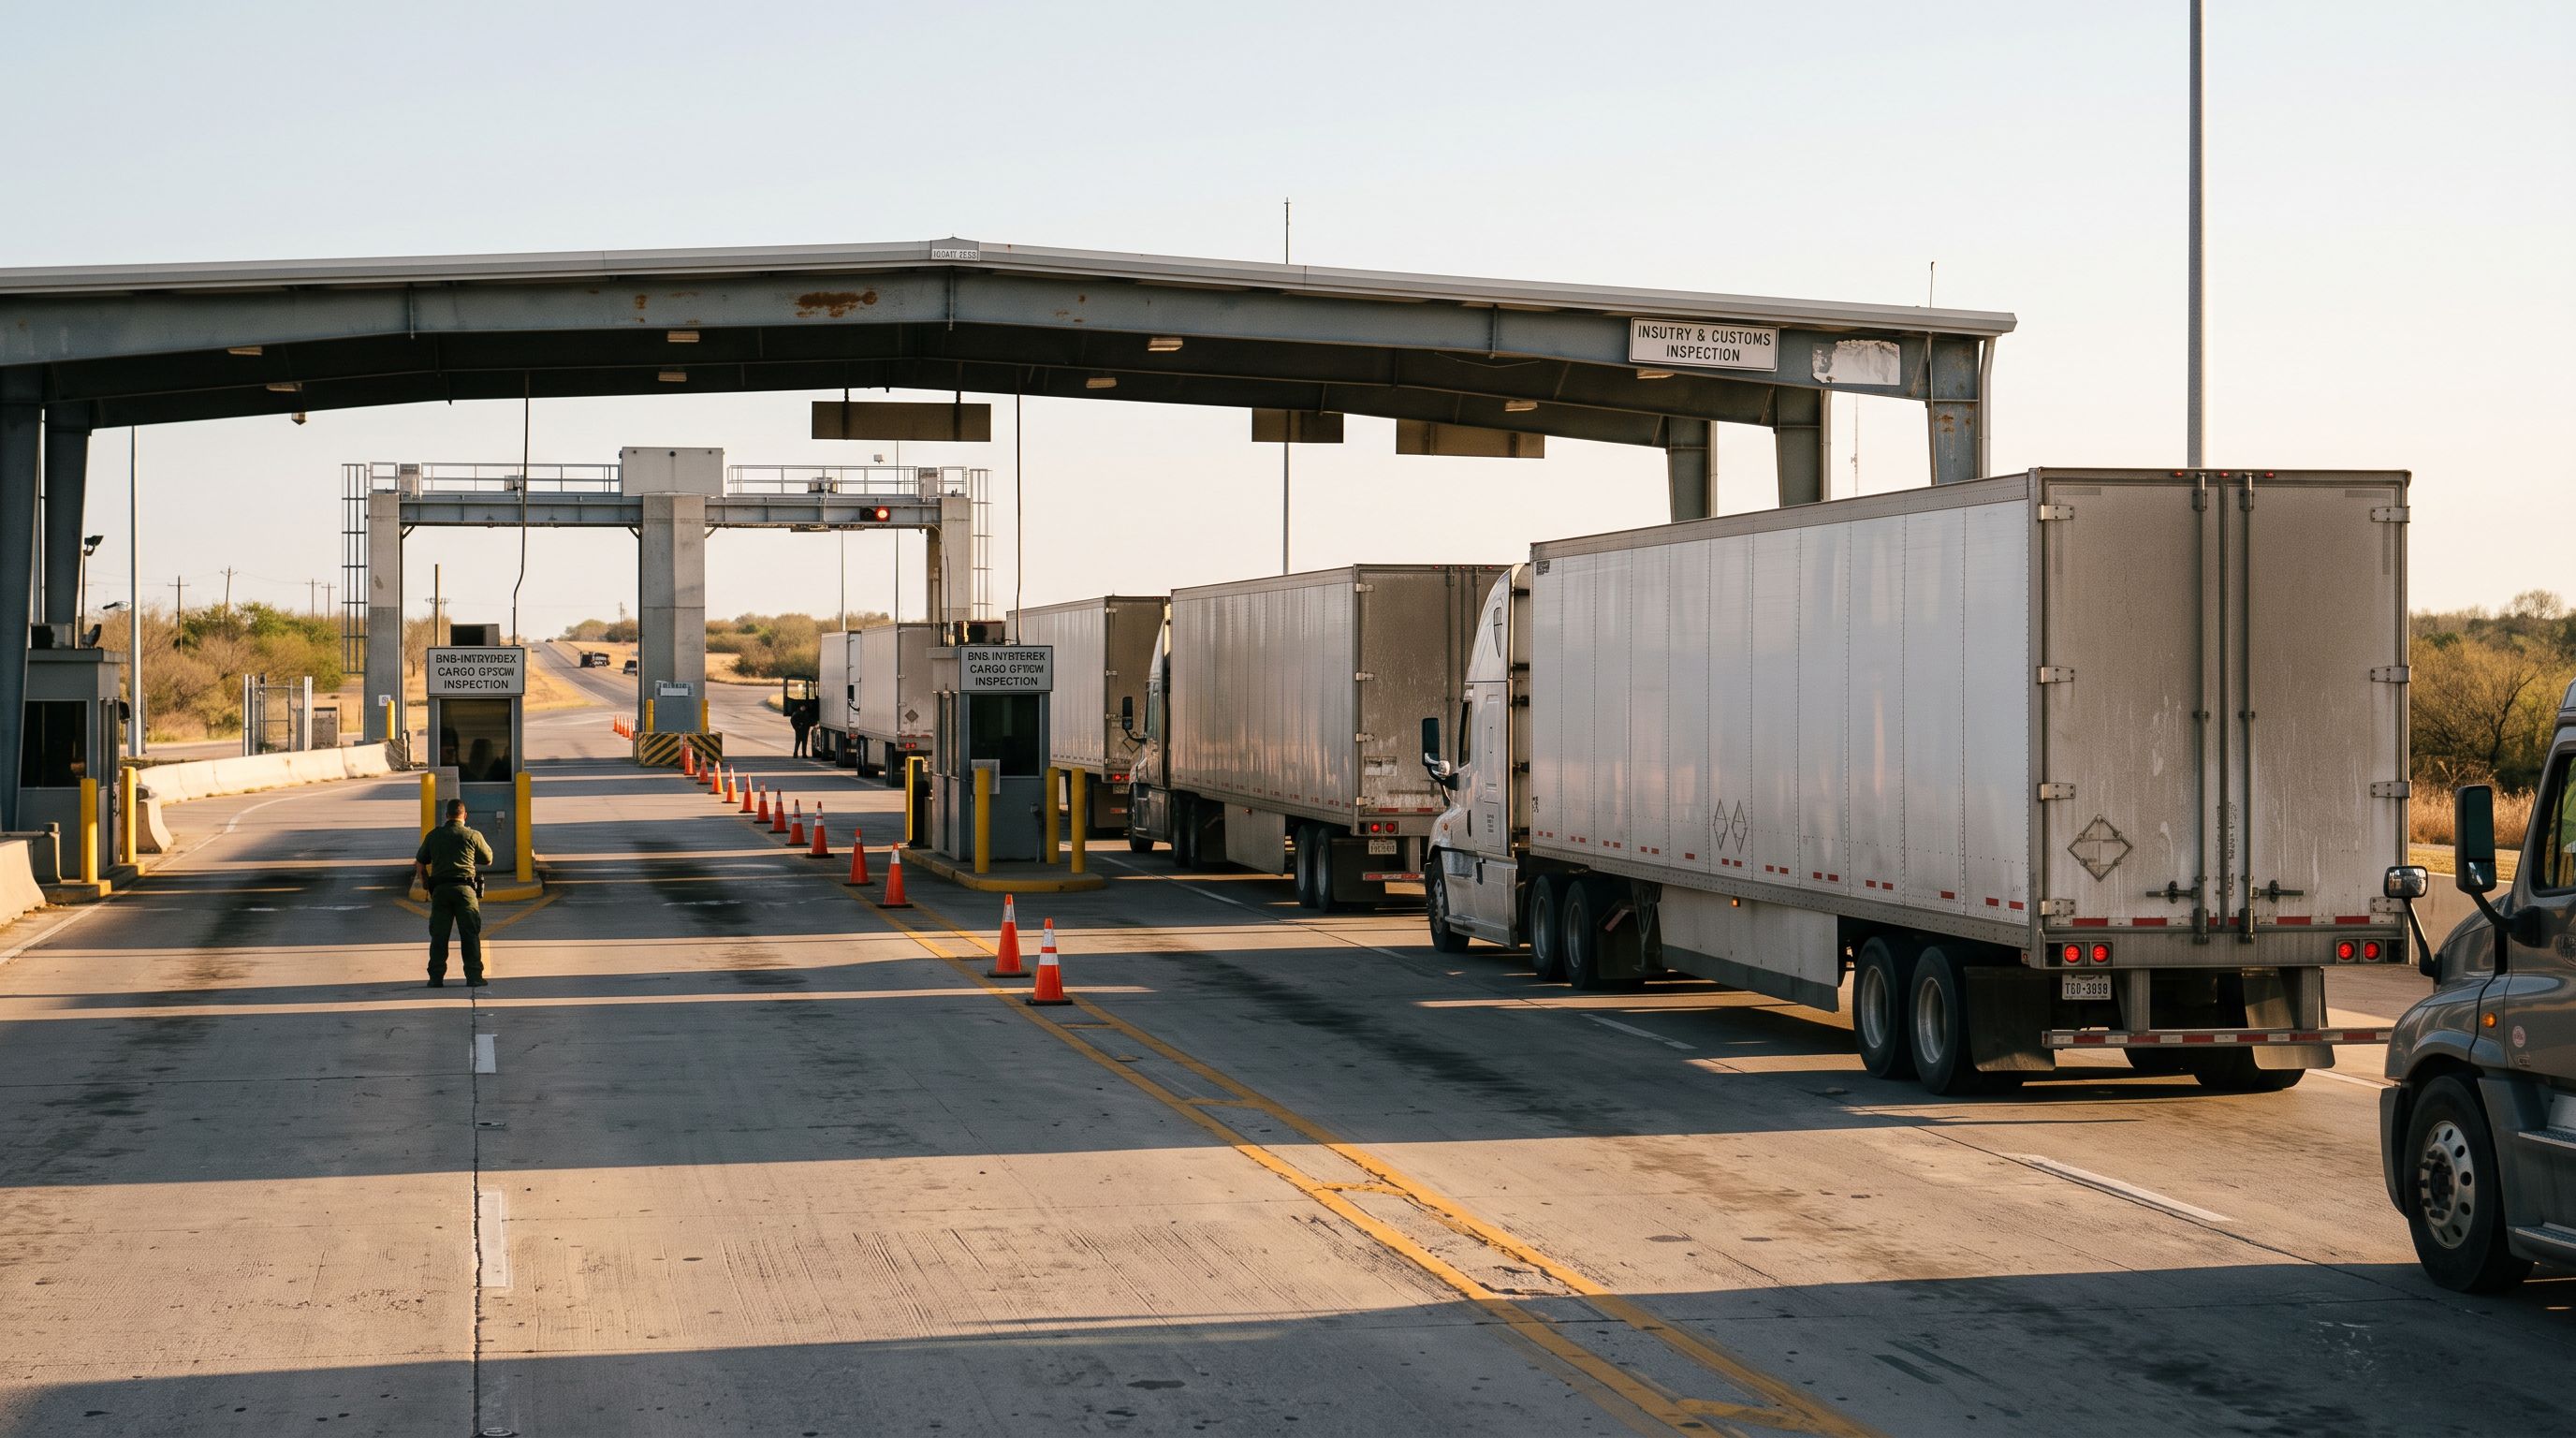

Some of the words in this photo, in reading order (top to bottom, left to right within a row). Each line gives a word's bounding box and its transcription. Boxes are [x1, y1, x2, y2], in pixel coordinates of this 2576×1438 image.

[1638, 325, 1691, 341] INSUTRY
[1697, 329, 1705, 342] &
[1712, 330, 1771, 346] CUSTOMS
[1666, 344, 1740, 361] INSPECTION
[438, 668, 475, 676] CARGO
[970, 664, 1006, 674] CARGO
[444, 680, 509, 689] INSPECTION
[975, 677, 1038, 686] INSPECTION
